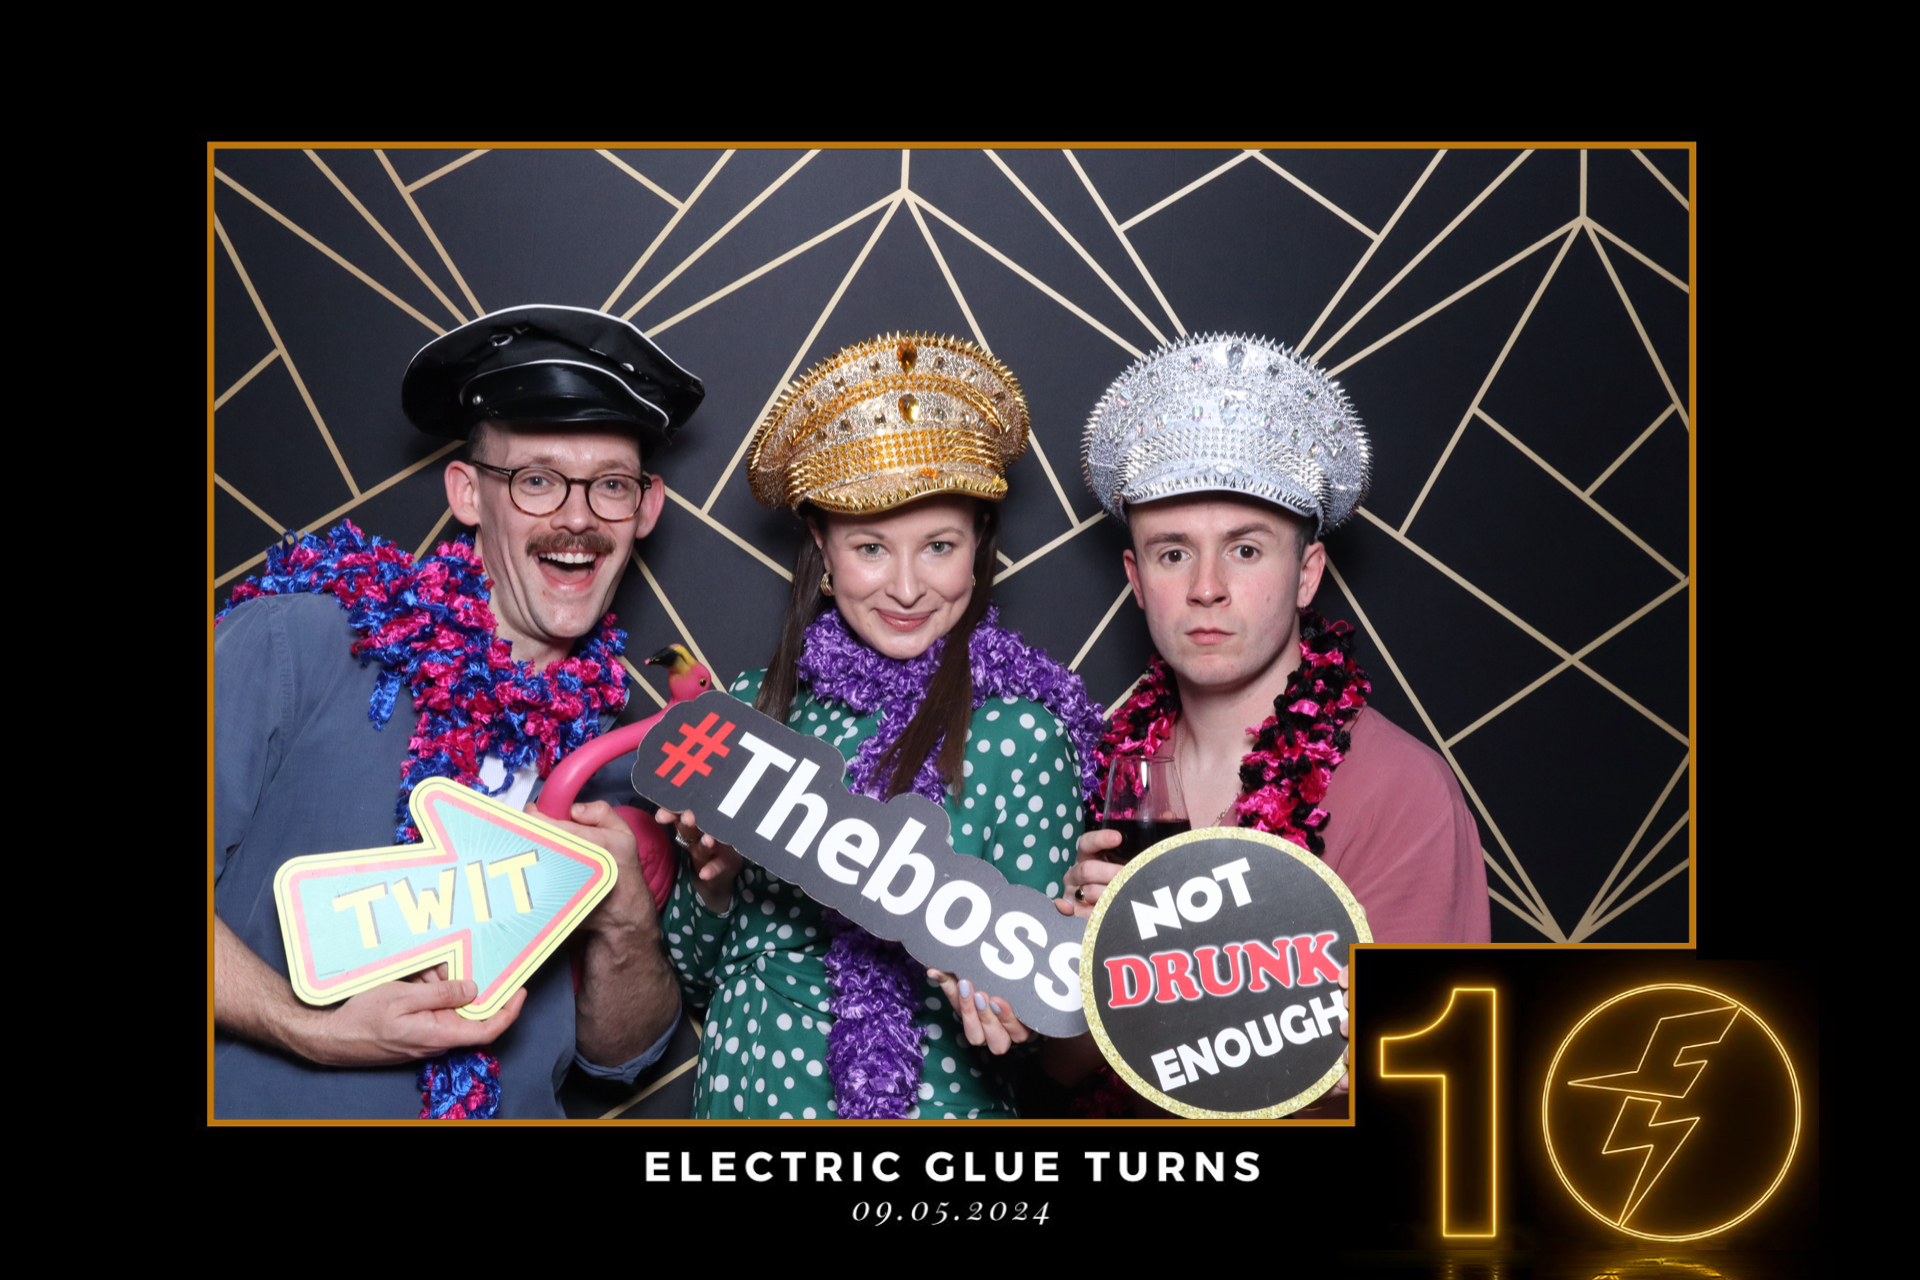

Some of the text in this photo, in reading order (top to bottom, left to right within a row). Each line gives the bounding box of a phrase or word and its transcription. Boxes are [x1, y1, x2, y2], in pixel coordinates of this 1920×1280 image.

[331, 848, 539, 950] TWIT
[654, 711, 1083, 1013] #Theboss
[1131, 857, 1252, 940] NOT
[1103, 931, 1342, 1010] DRUNK
[1151, 989, 1349, 1092] ENOUGH
